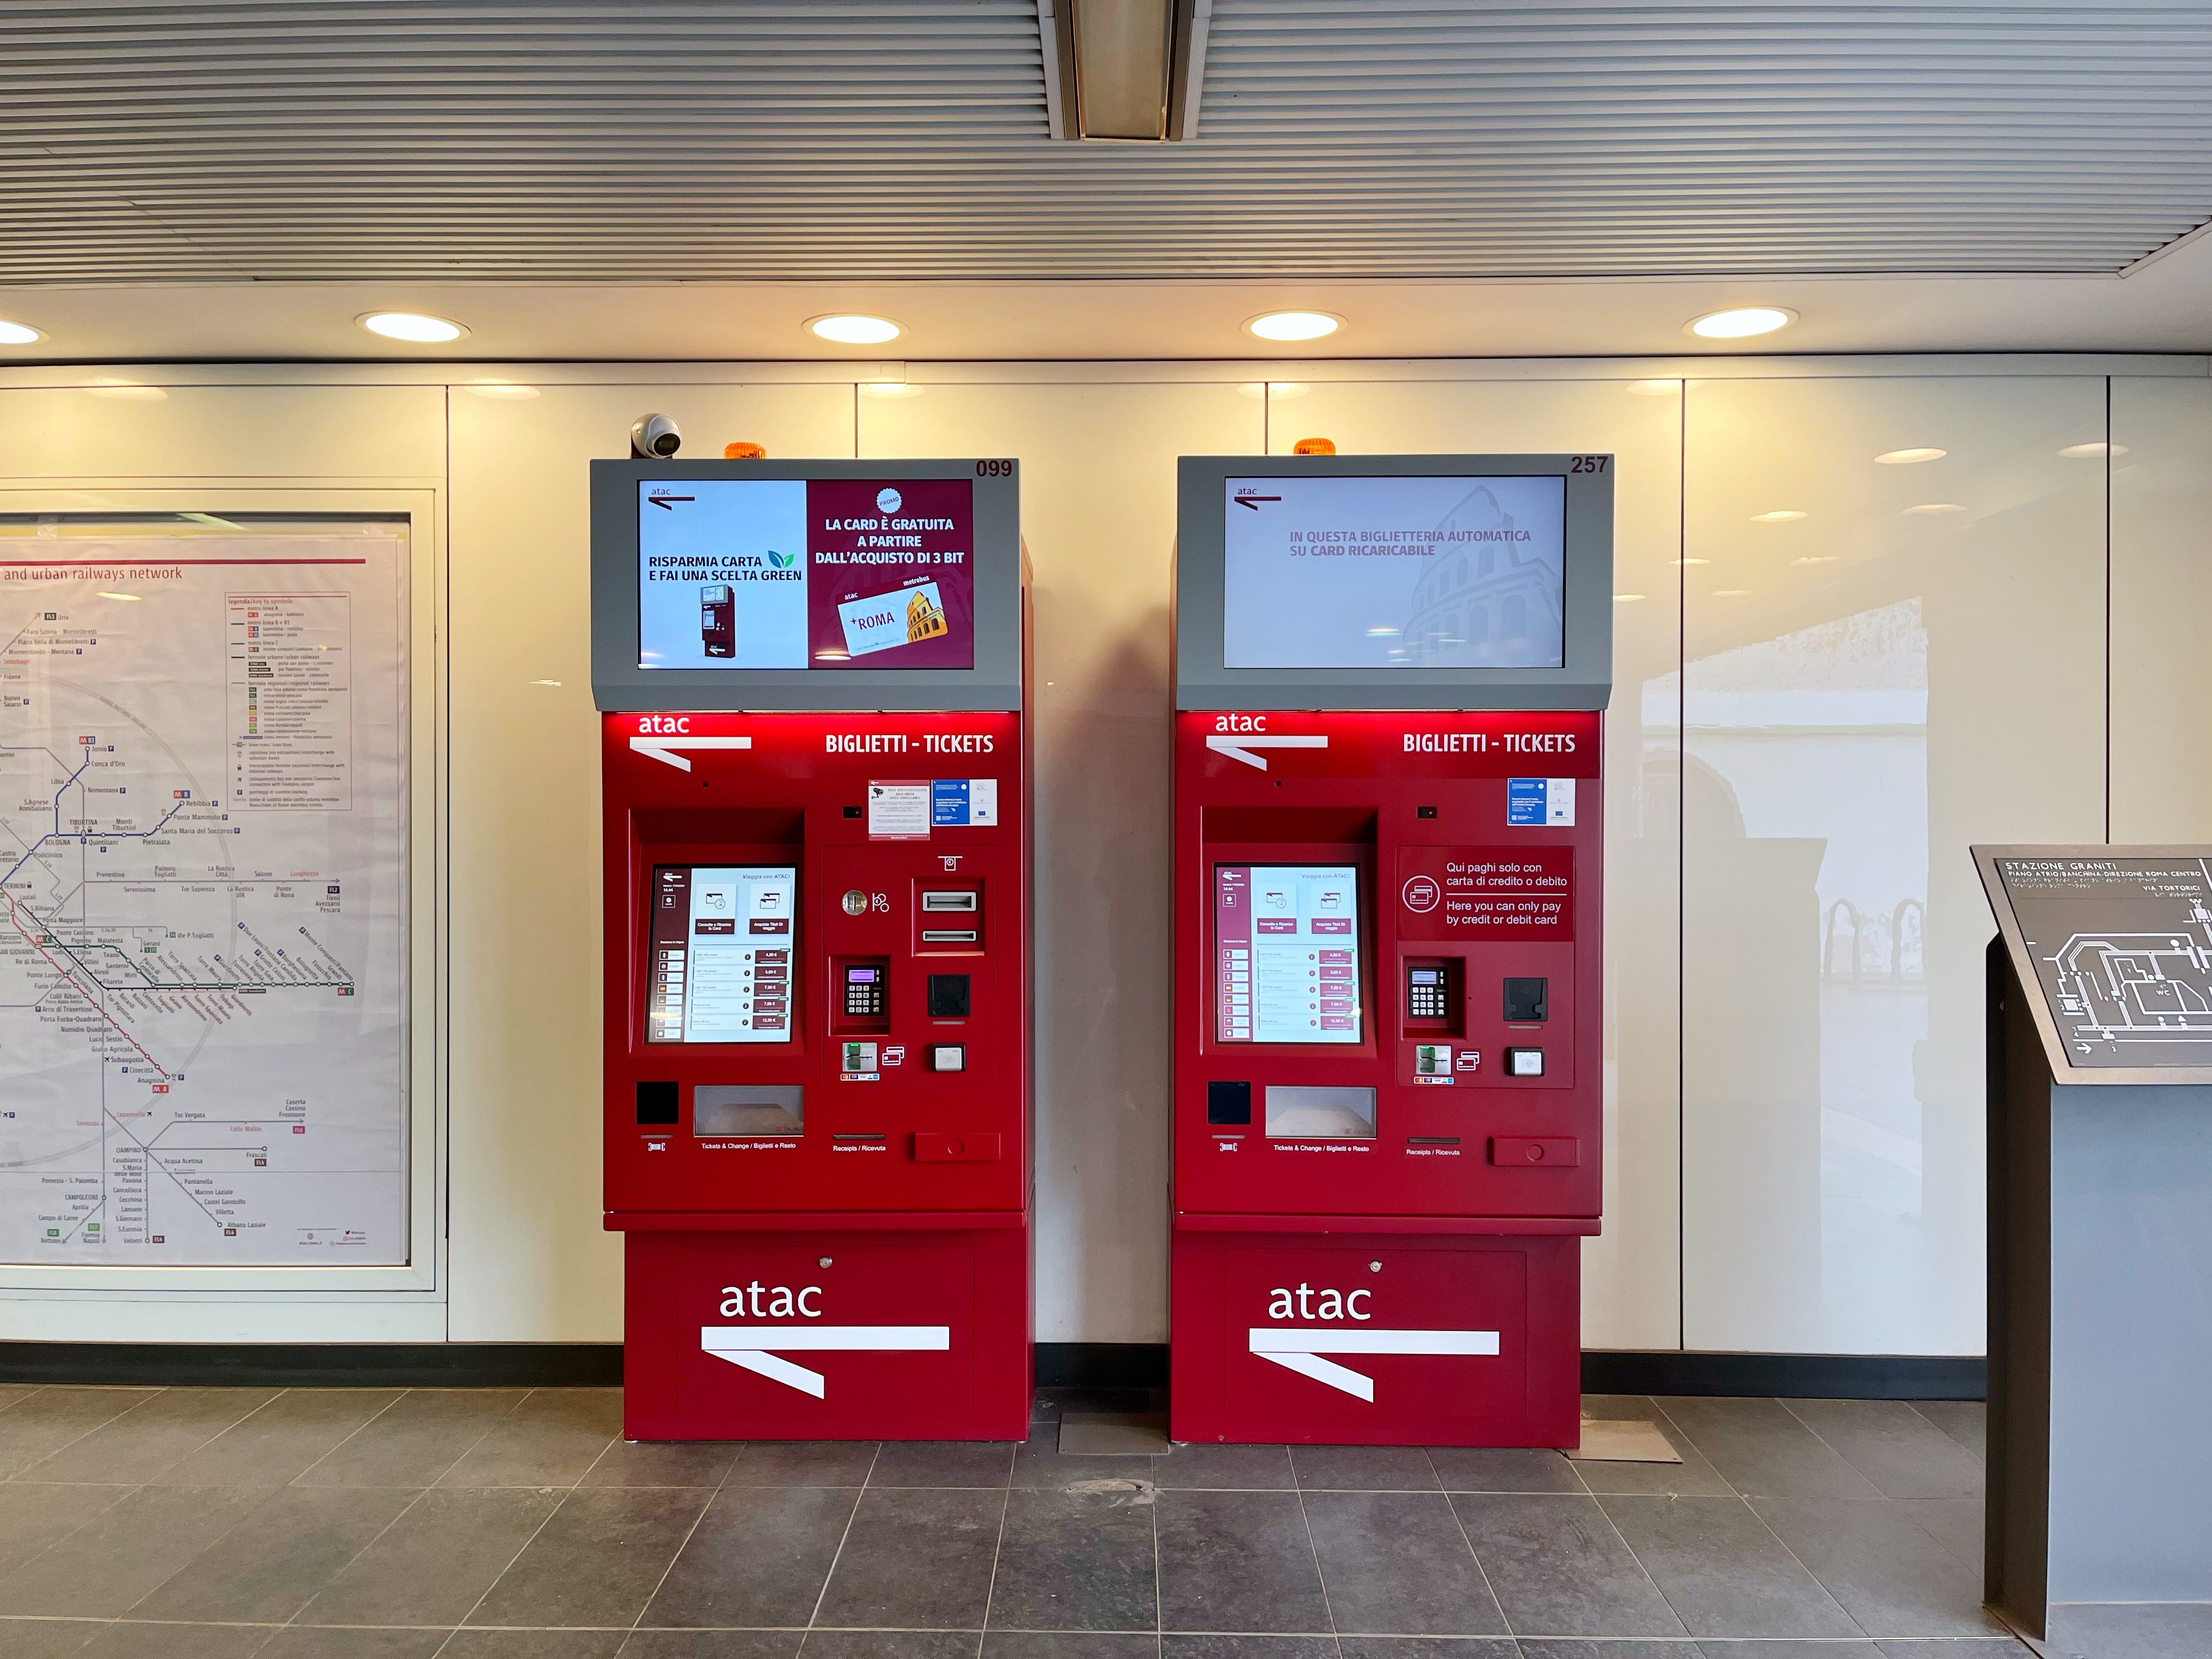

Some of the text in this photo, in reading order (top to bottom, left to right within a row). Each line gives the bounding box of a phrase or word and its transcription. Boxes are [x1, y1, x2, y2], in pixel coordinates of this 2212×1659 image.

[977, 460, 1012, 477] 099
[1571, 456, 1608, 473] 257
[879, 496, 899, 506] PROMO
[826, 516, 954, 530] LA CARD È GRATUITA
[857, 535, 921, 546] A PARTIRE
[1291, 531, 1531, 543] IN QUESTA BIGLIETTERIA AUTOMATICA
[1290, 545, 1435, 556] SU CARD RICARICABILE
[650, 557, 762, 567] RISPARMIA CARTA
[816, 552, 964, 565] DALL'ACQUISTO DI 3 BIT
[4, 567, 182, 581] and urban railways network
[650, 571, 801, 580] E FAI UNA SCELTA GREEN
[903, 575, 929, 586] metrebus
[639, 714, 689, 733] atac
[1216, 713, 1266, 731] atac
[826, 735, 906, 752] BIGLIETTI
[923, 735, 993, 752] TICKETS
[1404, 734, 1486, 752] BIGLIETTI
[1504, 734, 1575, 752] TICKETS
[1447, 862, 1464, 872] Qui
[1468, 863, 1496, 874] paghi
[1499, 863, 1520, 872] solo
[1447, 877, 1473, 885] carta
[1476, 876, 1485, 885] di
[1488, 876, 1523, 885] credito
[1536, 877, 1567, 885] debito
[1447, 901, 1471, 910] Here
[1475, 904, 1493, 912] you
[1518, 901, 1539, 912] only
[1543, 904, 1561, 913] pay
[1447, 915, 1459, 926] by
[1462, 915, 1490, 924] credit
[1506, 915, 1532, 924] debit
[1535, 915, 1556, 924] card
[720, 1281, 821, 1317] atac
[1269, 1283, 1370, 1319] atac
